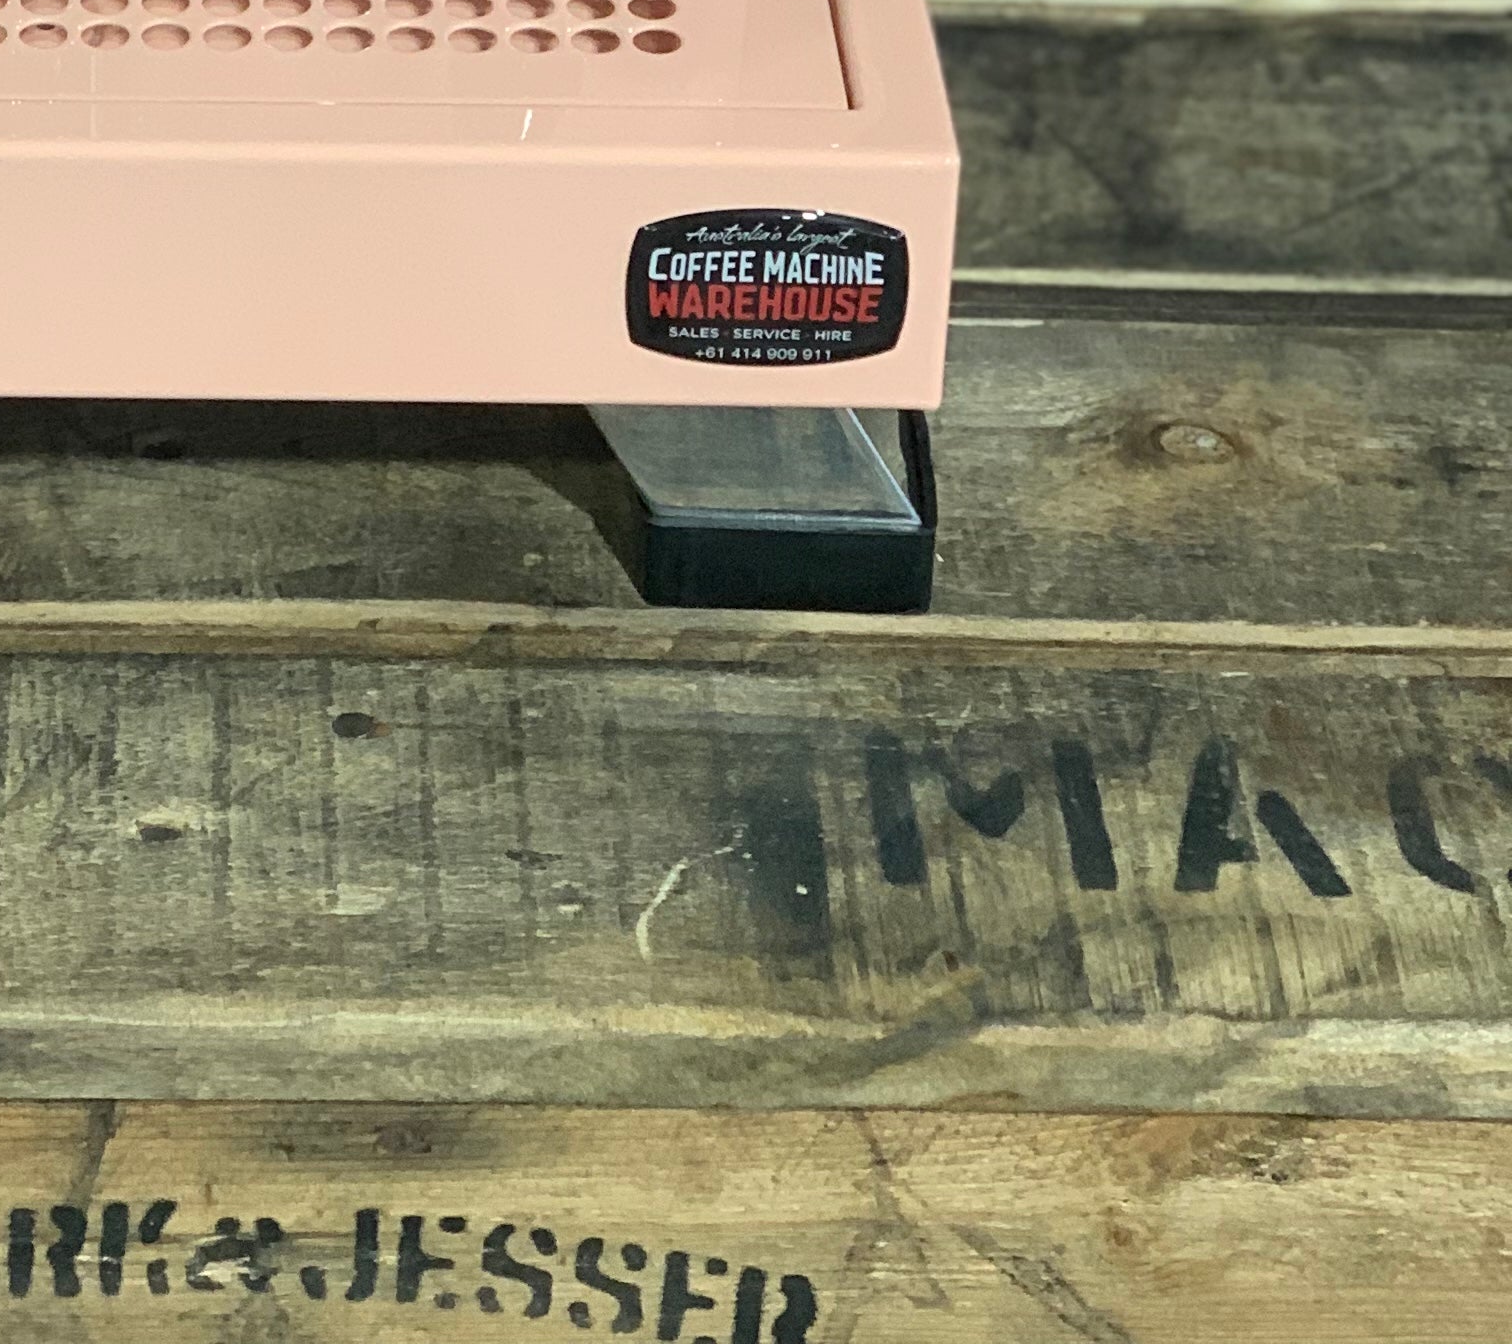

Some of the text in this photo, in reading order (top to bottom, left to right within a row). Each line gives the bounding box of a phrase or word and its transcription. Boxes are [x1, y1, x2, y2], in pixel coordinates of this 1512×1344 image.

[648, 247, 885, 285] COFFEE MACHINE
[648, 281, 883, 323] WAREHOUSE
[669, 326, 852, 342] SALES SERVICE HIRE
[695, 347, 831, 361] +61 414 909 911
